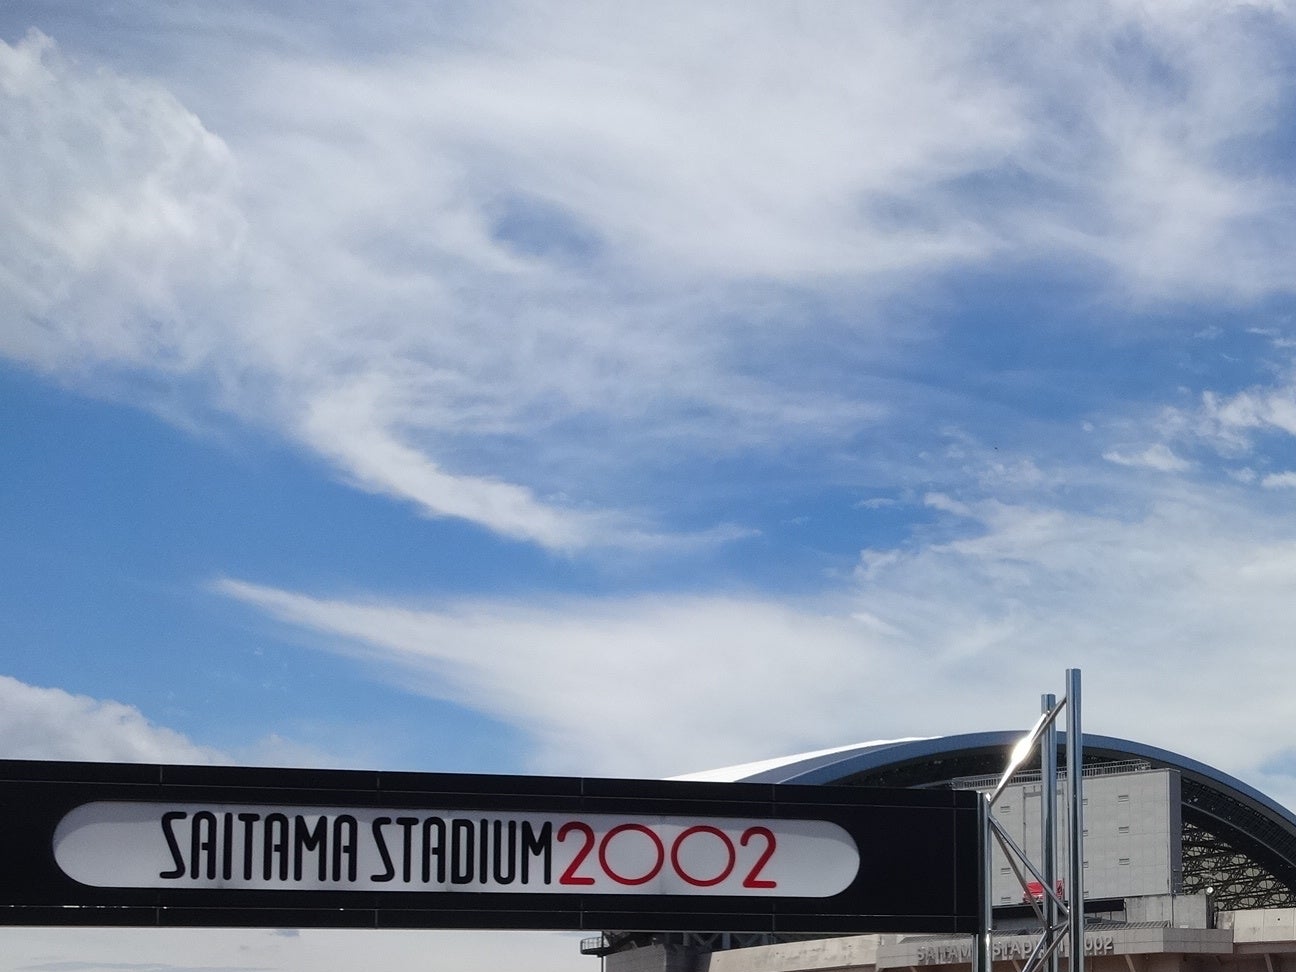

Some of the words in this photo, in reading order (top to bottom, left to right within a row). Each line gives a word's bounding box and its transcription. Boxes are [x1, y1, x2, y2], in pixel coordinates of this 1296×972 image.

[160, 809, 359, 882] SAITAMA
[917, 942, 975, 962] SAITAM
[1084, 936, 1114, 951] 002
